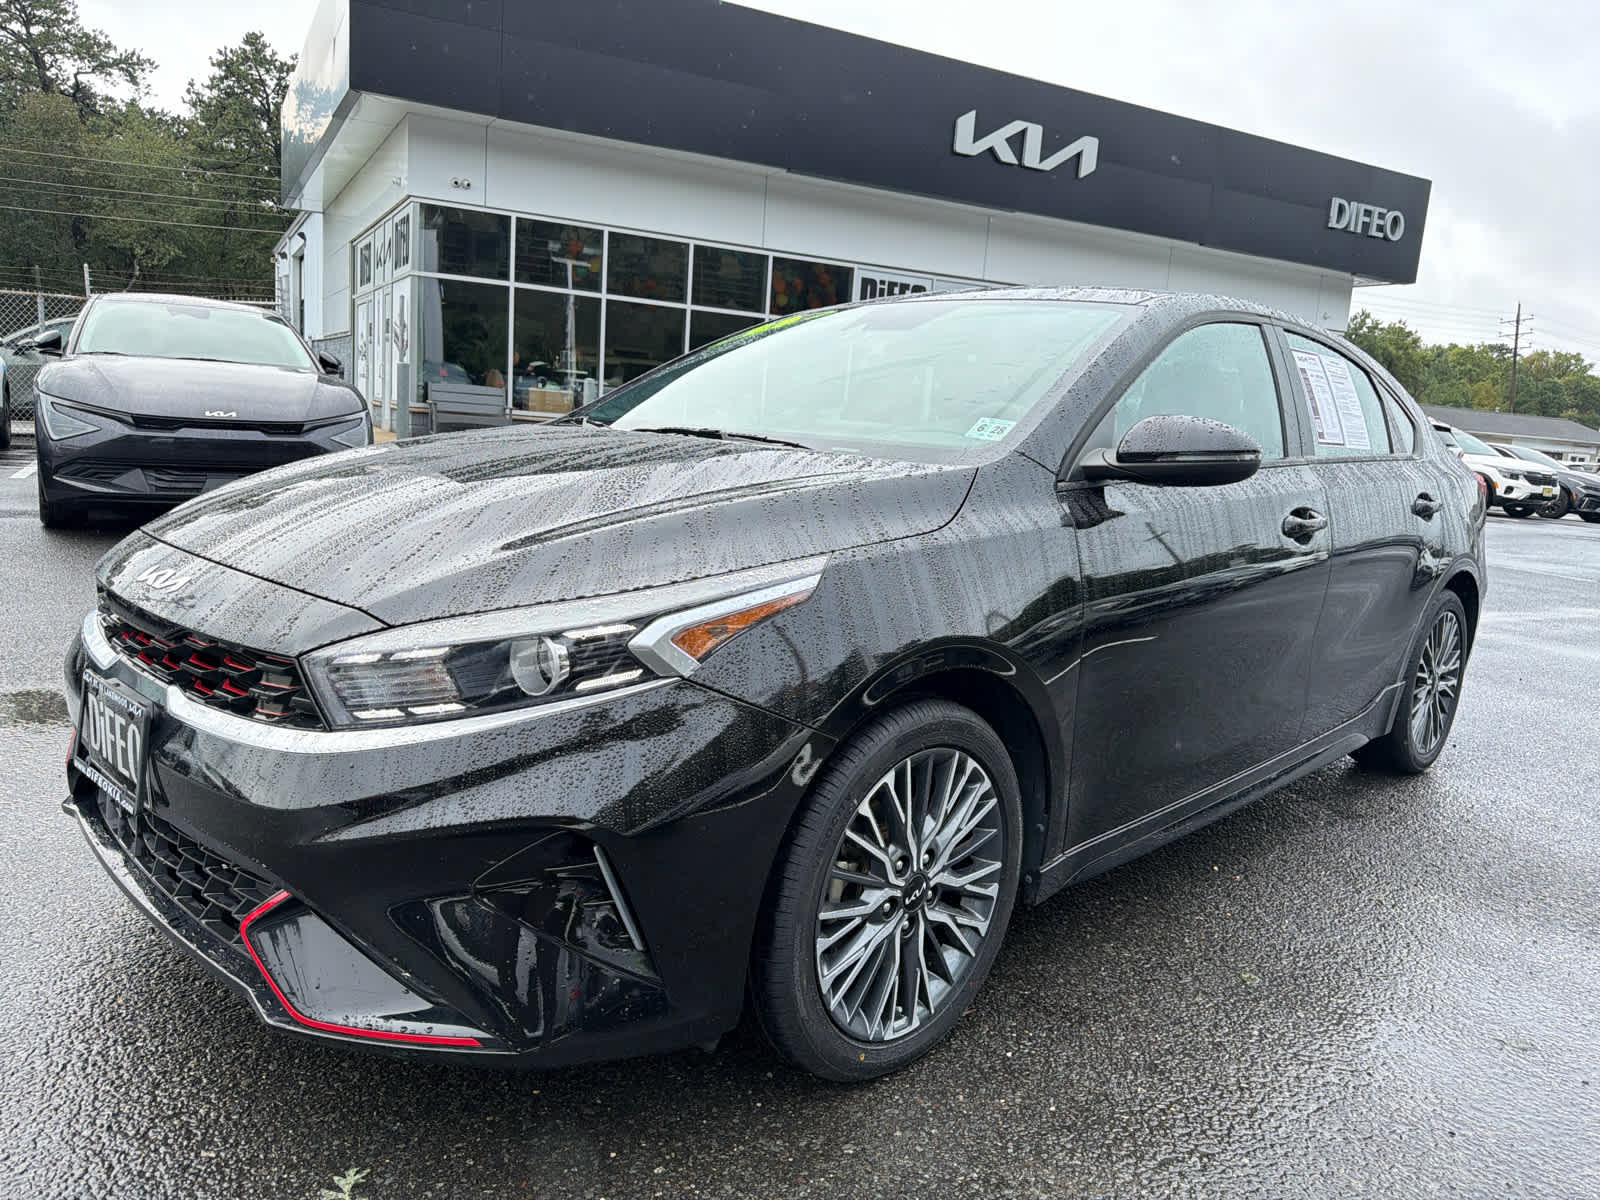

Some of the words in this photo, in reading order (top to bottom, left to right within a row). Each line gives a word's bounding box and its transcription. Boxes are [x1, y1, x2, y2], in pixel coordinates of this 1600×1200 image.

[954, 109, 1099, 178] KIA
[1328, 196, 1405, 241] DIFEO
[88, 692, 141, 785] DiFEO
